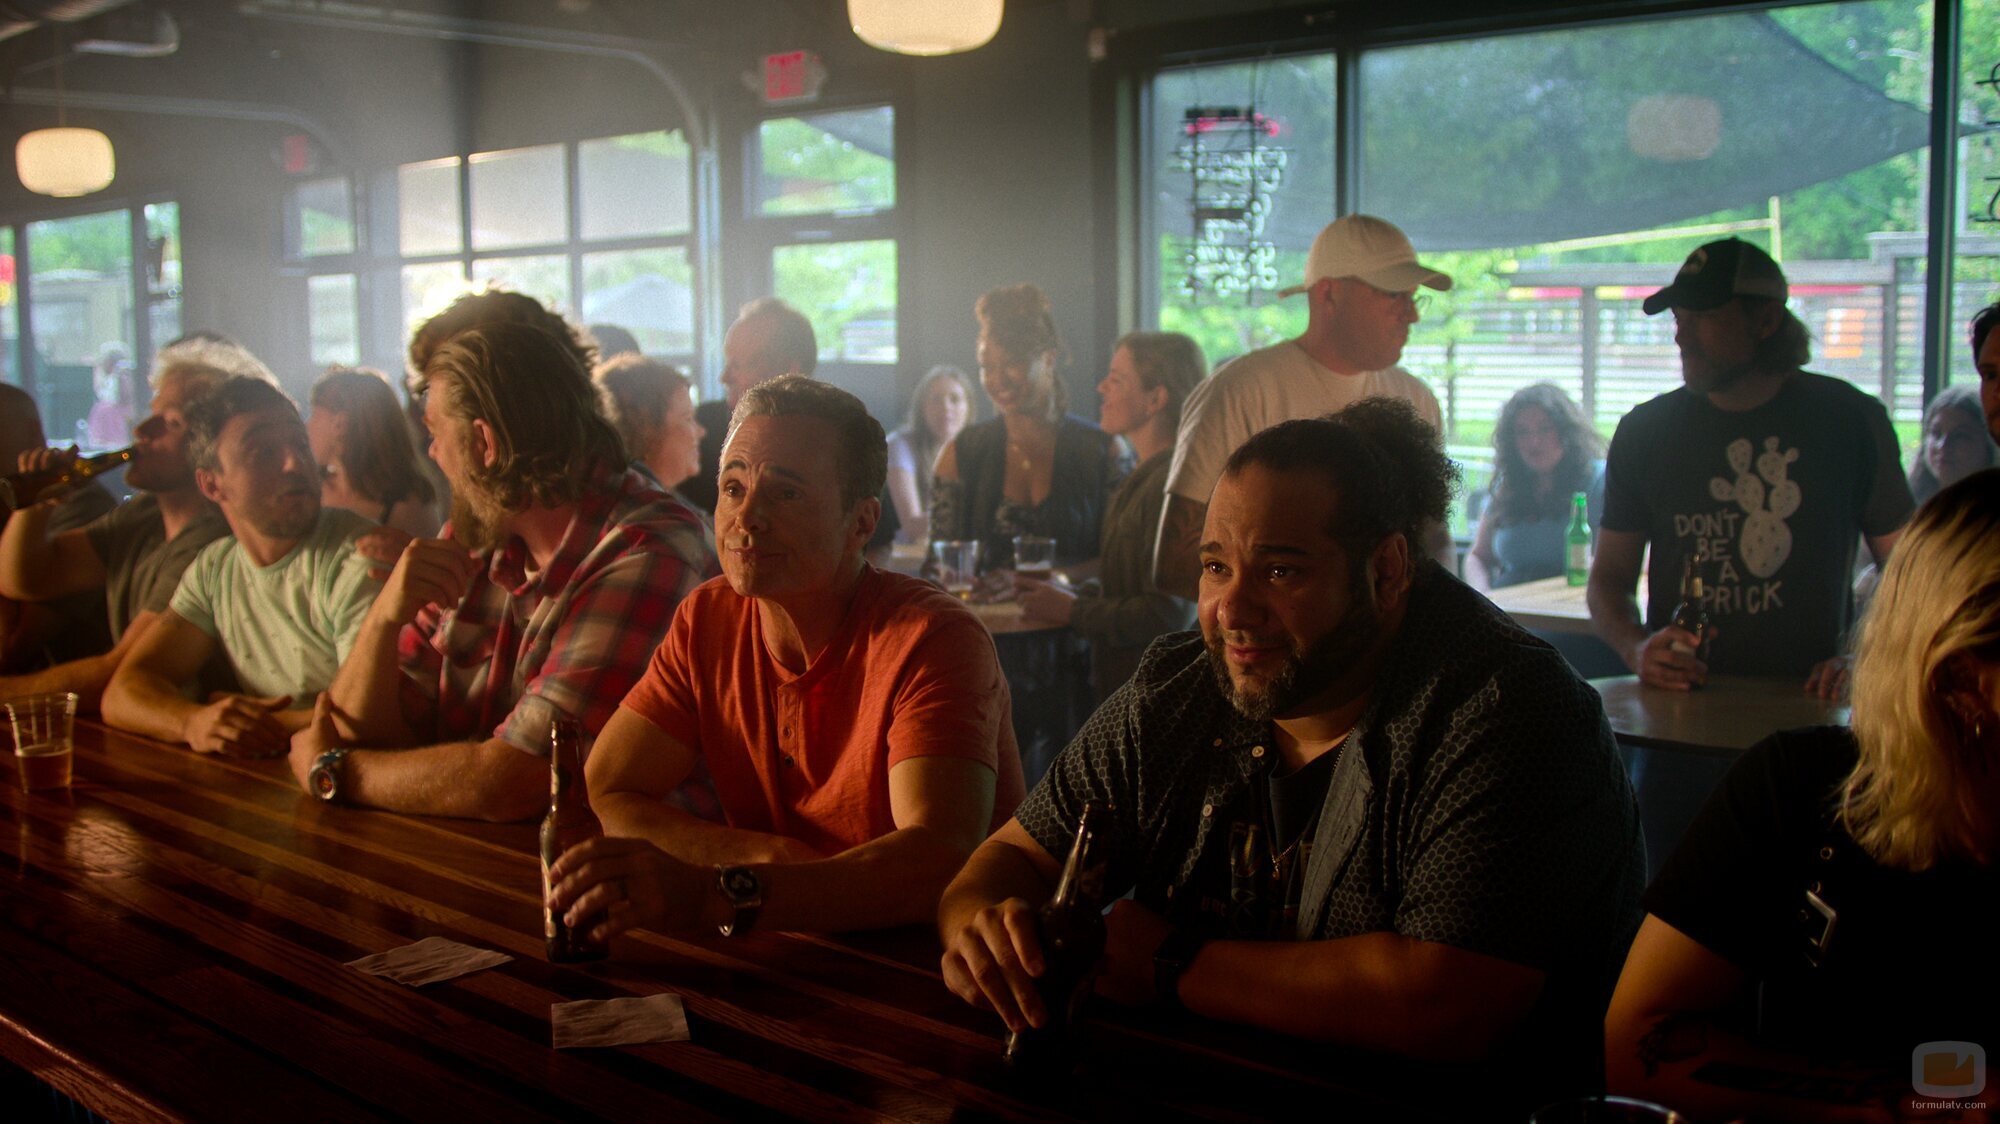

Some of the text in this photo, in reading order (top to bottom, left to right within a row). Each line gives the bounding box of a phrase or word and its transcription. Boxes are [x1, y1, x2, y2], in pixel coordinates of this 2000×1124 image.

[1673, 508, 1740, 538] DON'T
[1696, 538, 1732, 562] BE
[1719, 561, 1740, 583] A
[1700, 581, 1784, 614] PRICK
